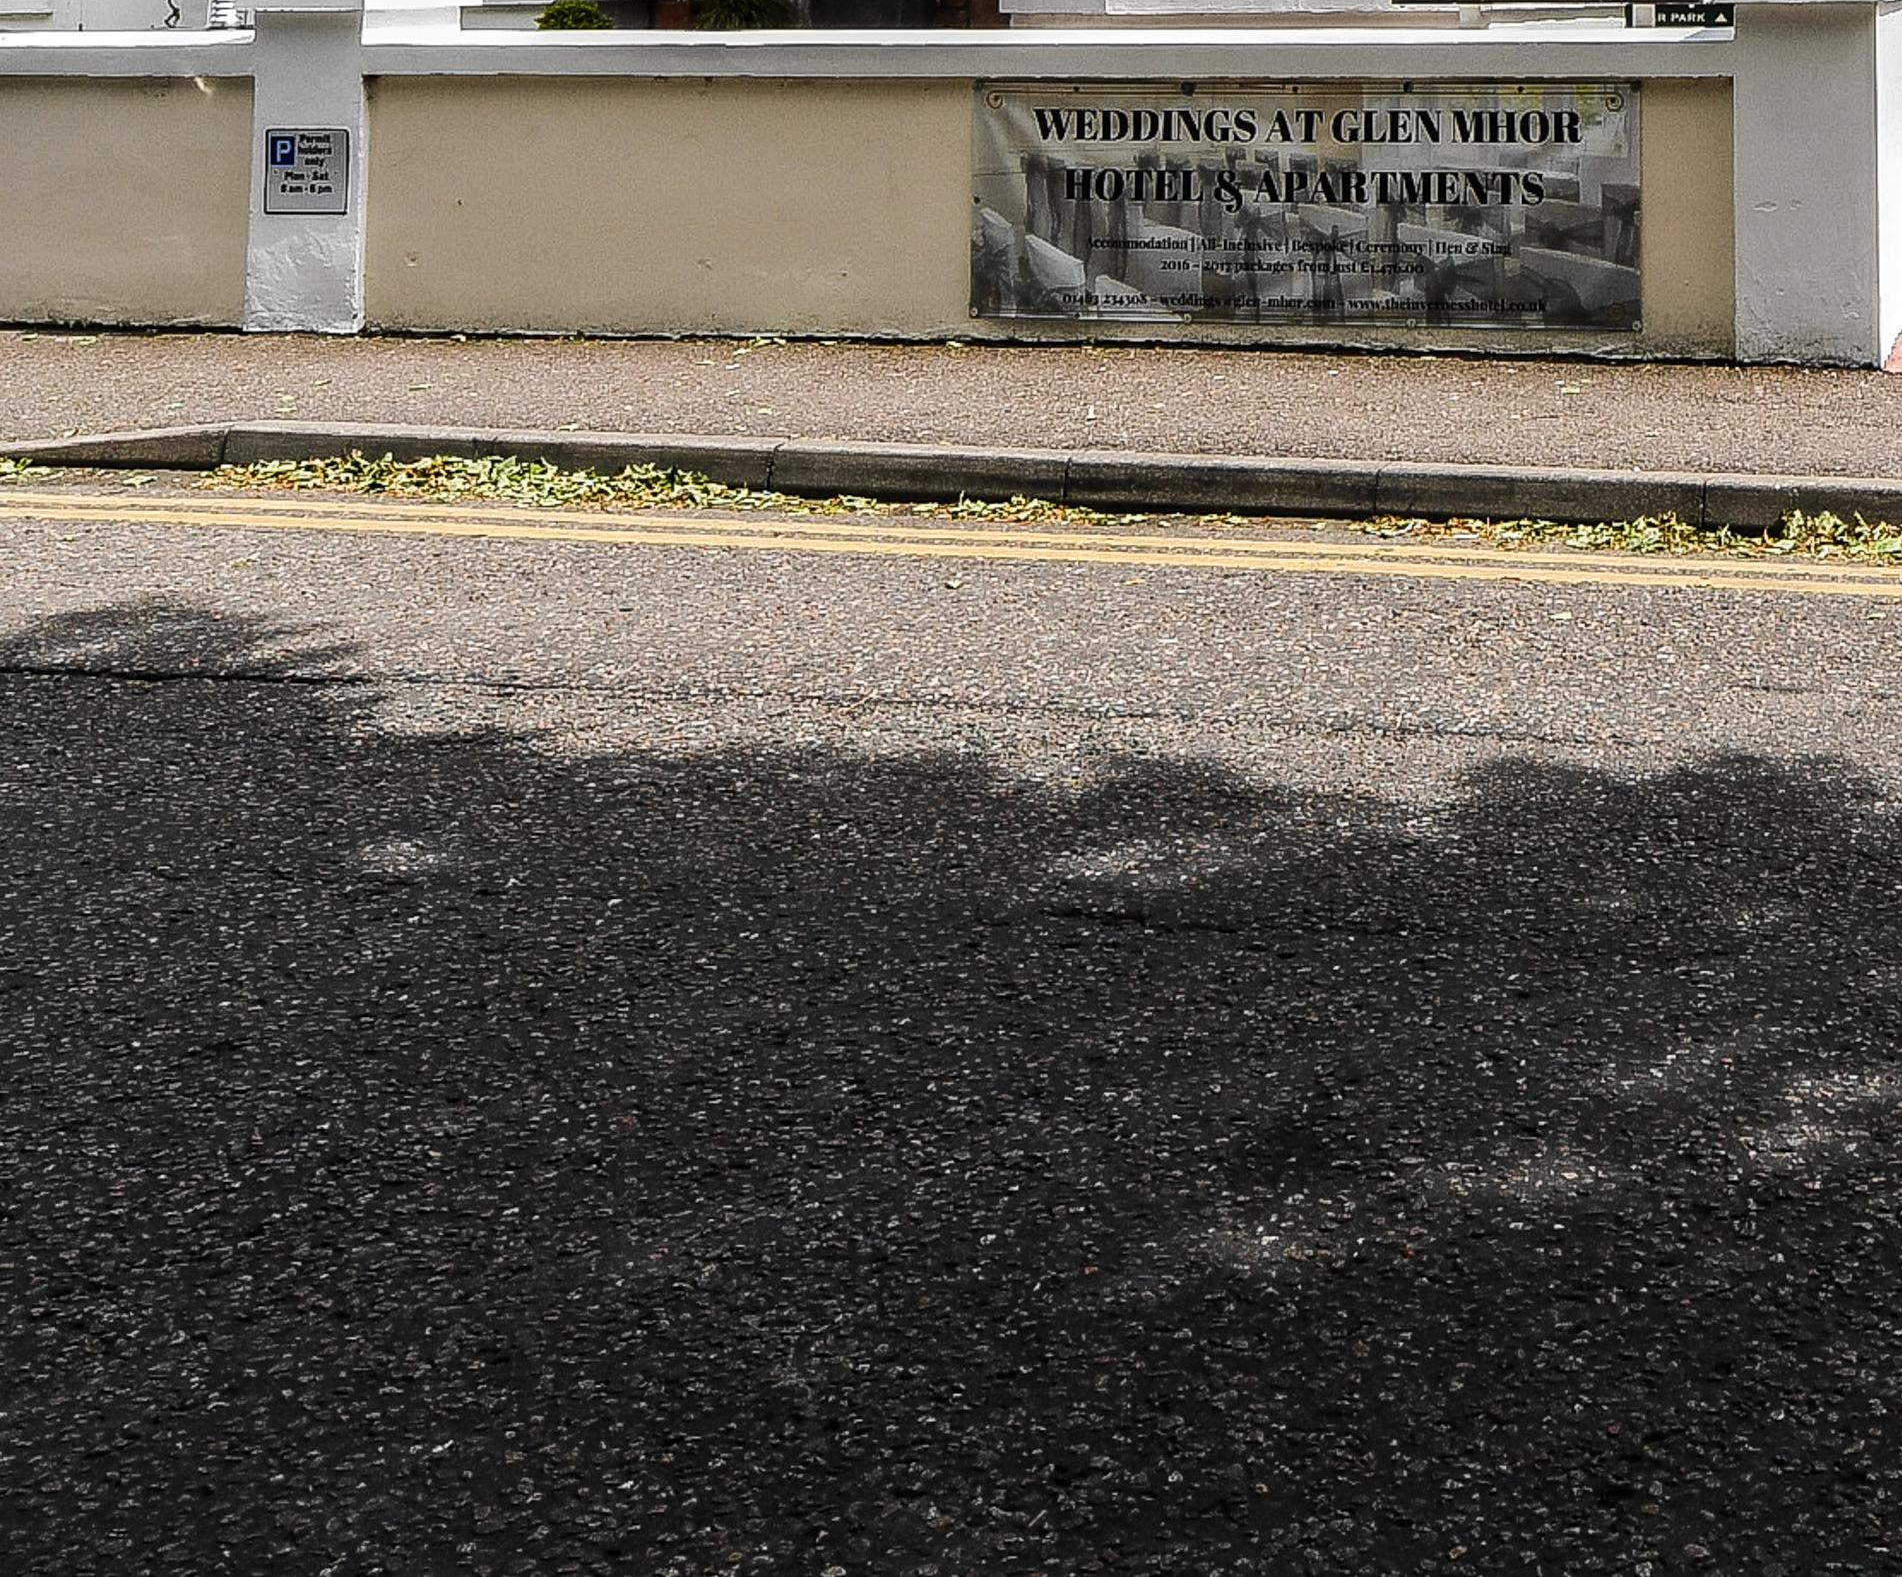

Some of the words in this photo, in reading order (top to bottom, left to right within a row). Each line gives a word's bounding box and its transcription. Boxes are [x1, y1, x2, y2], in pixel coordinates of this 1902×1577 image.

[1670, 12, 1706, 23] PARK
[1033, 109, 1257, 143] WEDDINGS
[1265, 109, 1324, 144] AT
[1331, 109, 1442, 144] GLEN
[1451, 109, 1583, 145] MHOR
[298, 133, 331, 144] Permit
[276, 140, 291, 163] P
[298, 145, 332, 156] holders
[304, 156, 326, 168] only
[283, 171, 305, 181] Mon
[311, 171, 330, 181] Sat
[1064, 168, 1204, 202] HOTEL
[1213, 169, 1243, 214] &
[1253, 170, 1545, 206] APARTMENTS
[1089, 236, 1189, 250] Accommodation
[1200, 236, 1282, 253] All-Inclusive
[1291, 238, 1347, 255] Bespoke
[1356, 240, 1424, 257] Ceremony
[1436, 241, 1462, 255] Hen
[1465, 241, 1479, 255] &
[1480, 241, 1513, 257] Stag
[1160, 259, 1189, 272] 2016
[1234, 259, 1294, 276] packages
[1297, 259, 1330, 273] from
[1332, 259, 1357, 276] just
